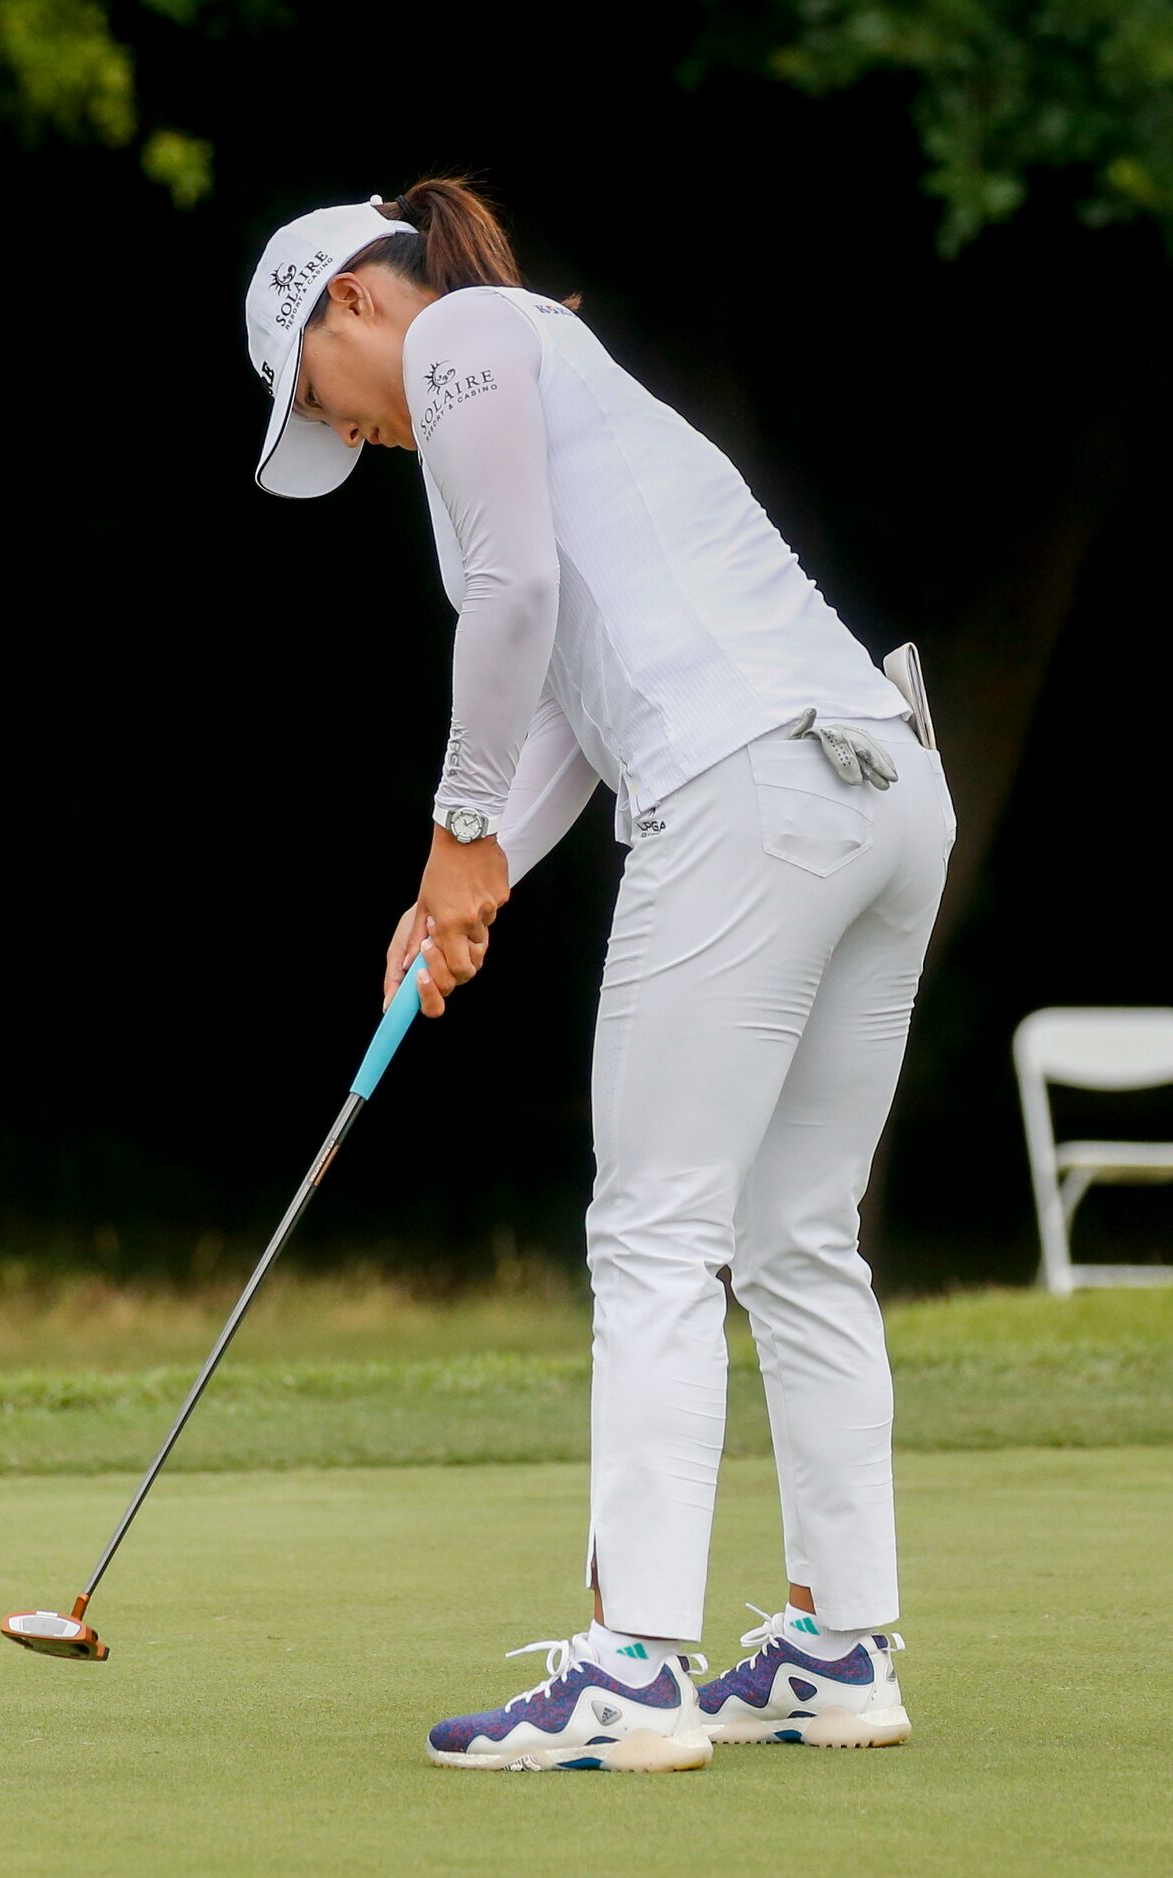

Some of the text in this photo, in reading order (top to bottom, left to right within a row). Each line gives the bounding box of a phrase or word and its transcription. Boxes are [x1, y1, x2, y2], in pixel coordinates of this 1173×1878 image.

[308, 257, 334, 285] CASINO
[275, 251, 328, 327] SOLAIRE
[420, 369, 495, 435] SOLAIRE
[457, 384, 498, 403] CASINO
[636, 820, 666, 832] LPGA
